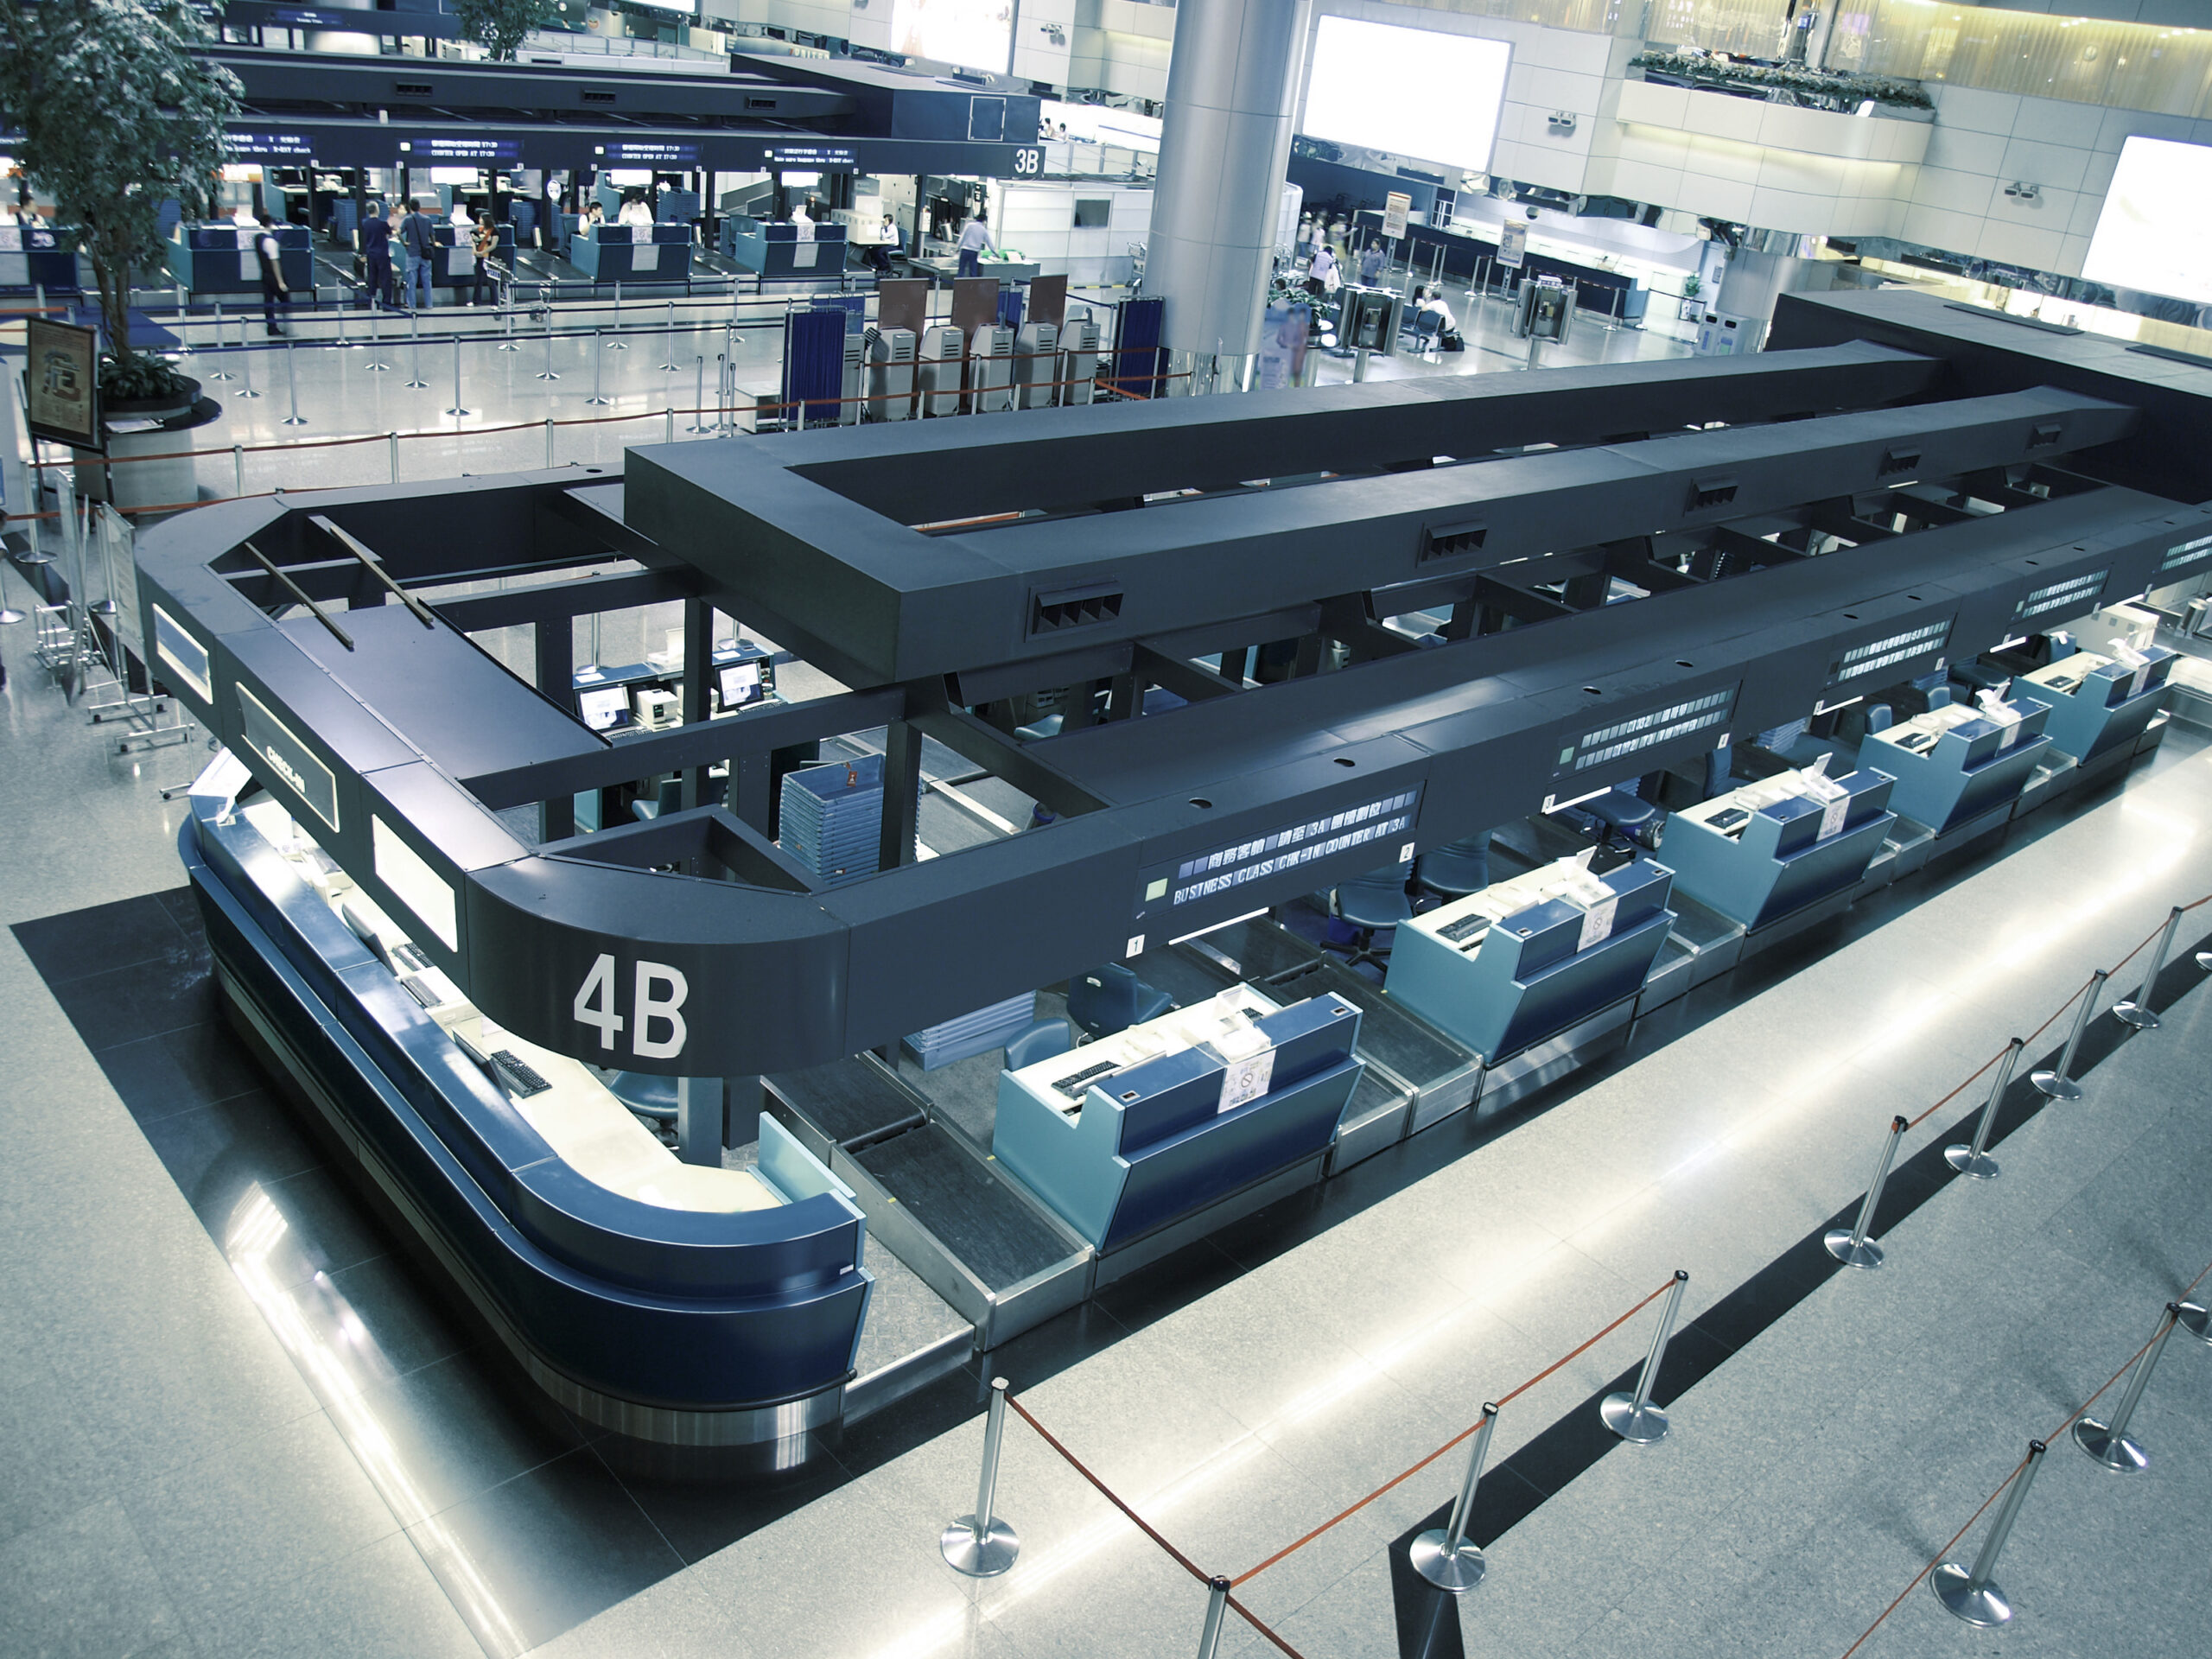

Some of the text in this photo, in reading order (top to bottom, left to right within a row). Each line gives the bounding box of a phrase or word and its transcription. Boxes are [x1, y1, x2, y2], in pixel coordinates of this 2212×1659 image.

[1014, 149, 1039, 174] 3B
[1310, 821, 1325, 836] 3A
[1173, 816, 1406, 906] BUSINESS CLASS CHK-IN COUNTER AT 3A
[574, 953, 689, 1059] 4B
